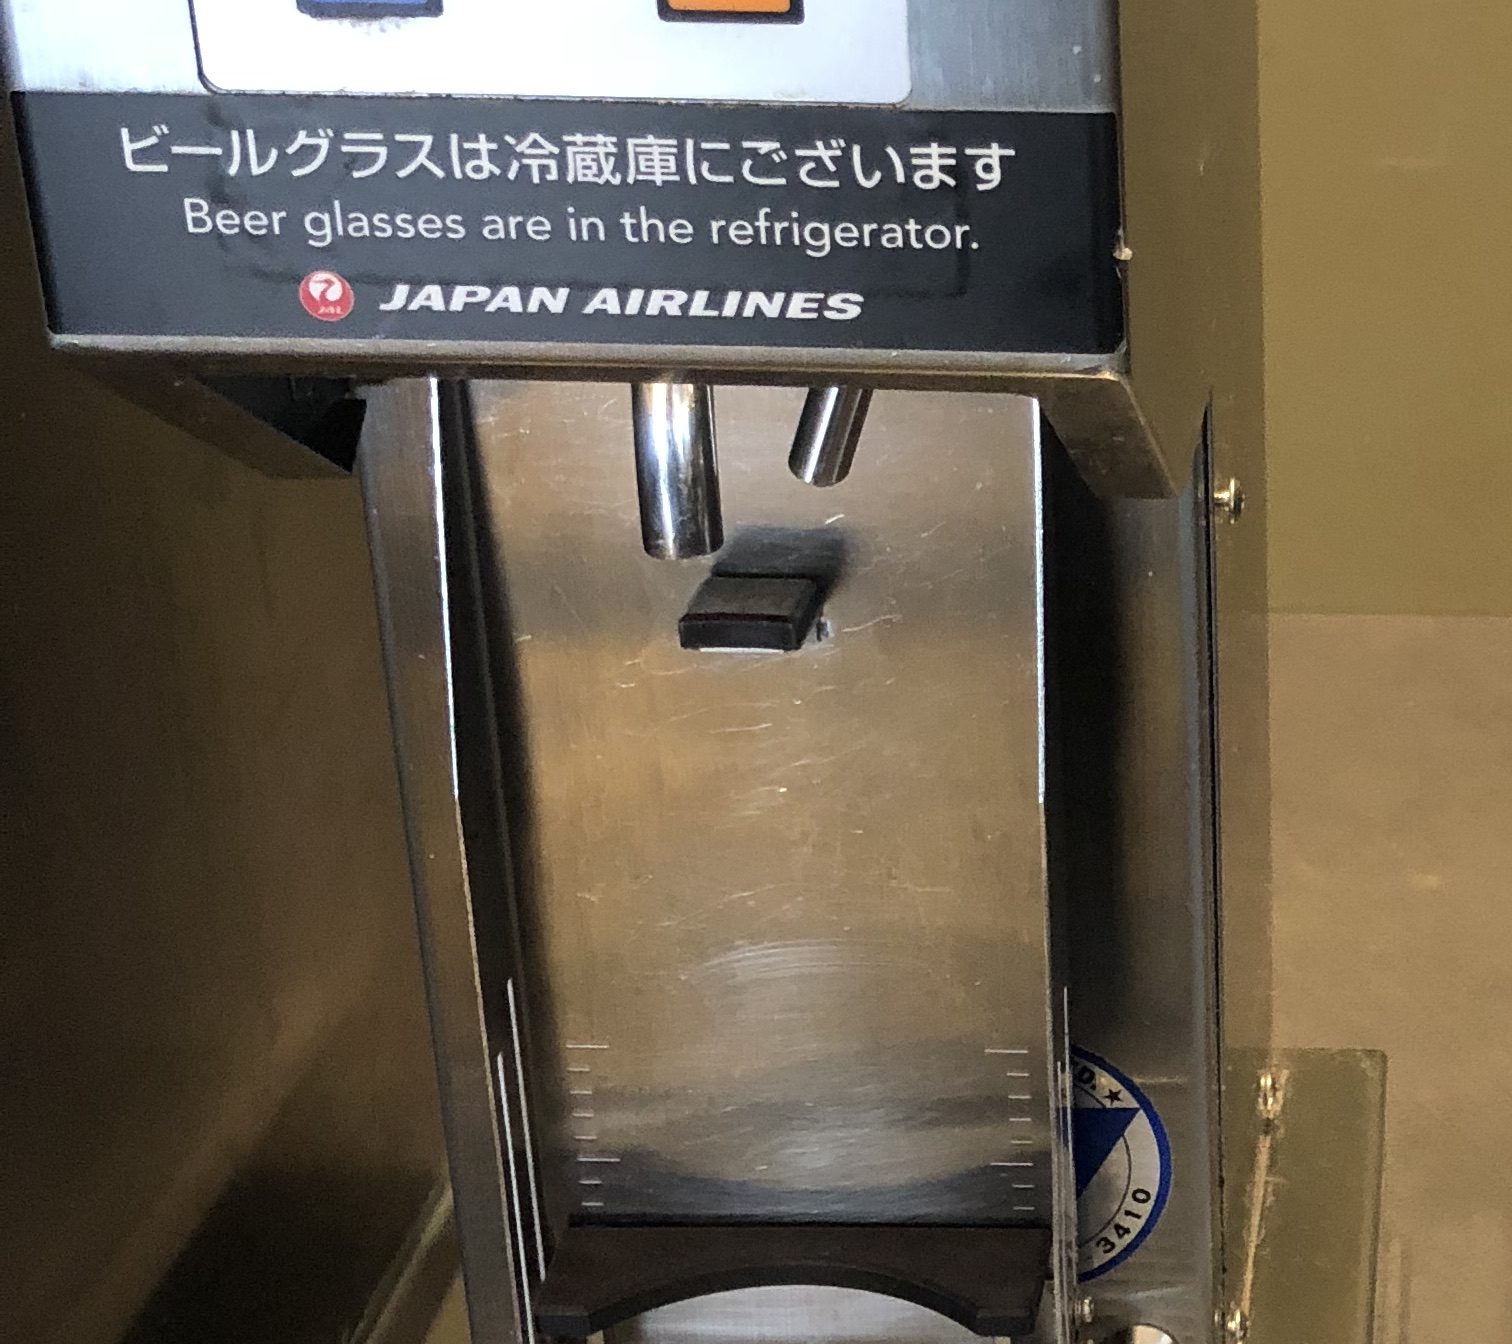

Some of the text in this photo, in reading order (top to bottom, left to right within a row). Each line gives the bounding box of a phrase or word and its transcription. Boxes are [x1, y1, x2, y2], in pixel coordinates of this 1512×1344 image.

[120, 125, 1016, 192] ビールグラスは冷蔵庫にございます
[184, 197, 980, 258] Beer glasses are in the refrigerator.
[378, 283, 864, 321] JAPAN AIRLINES
